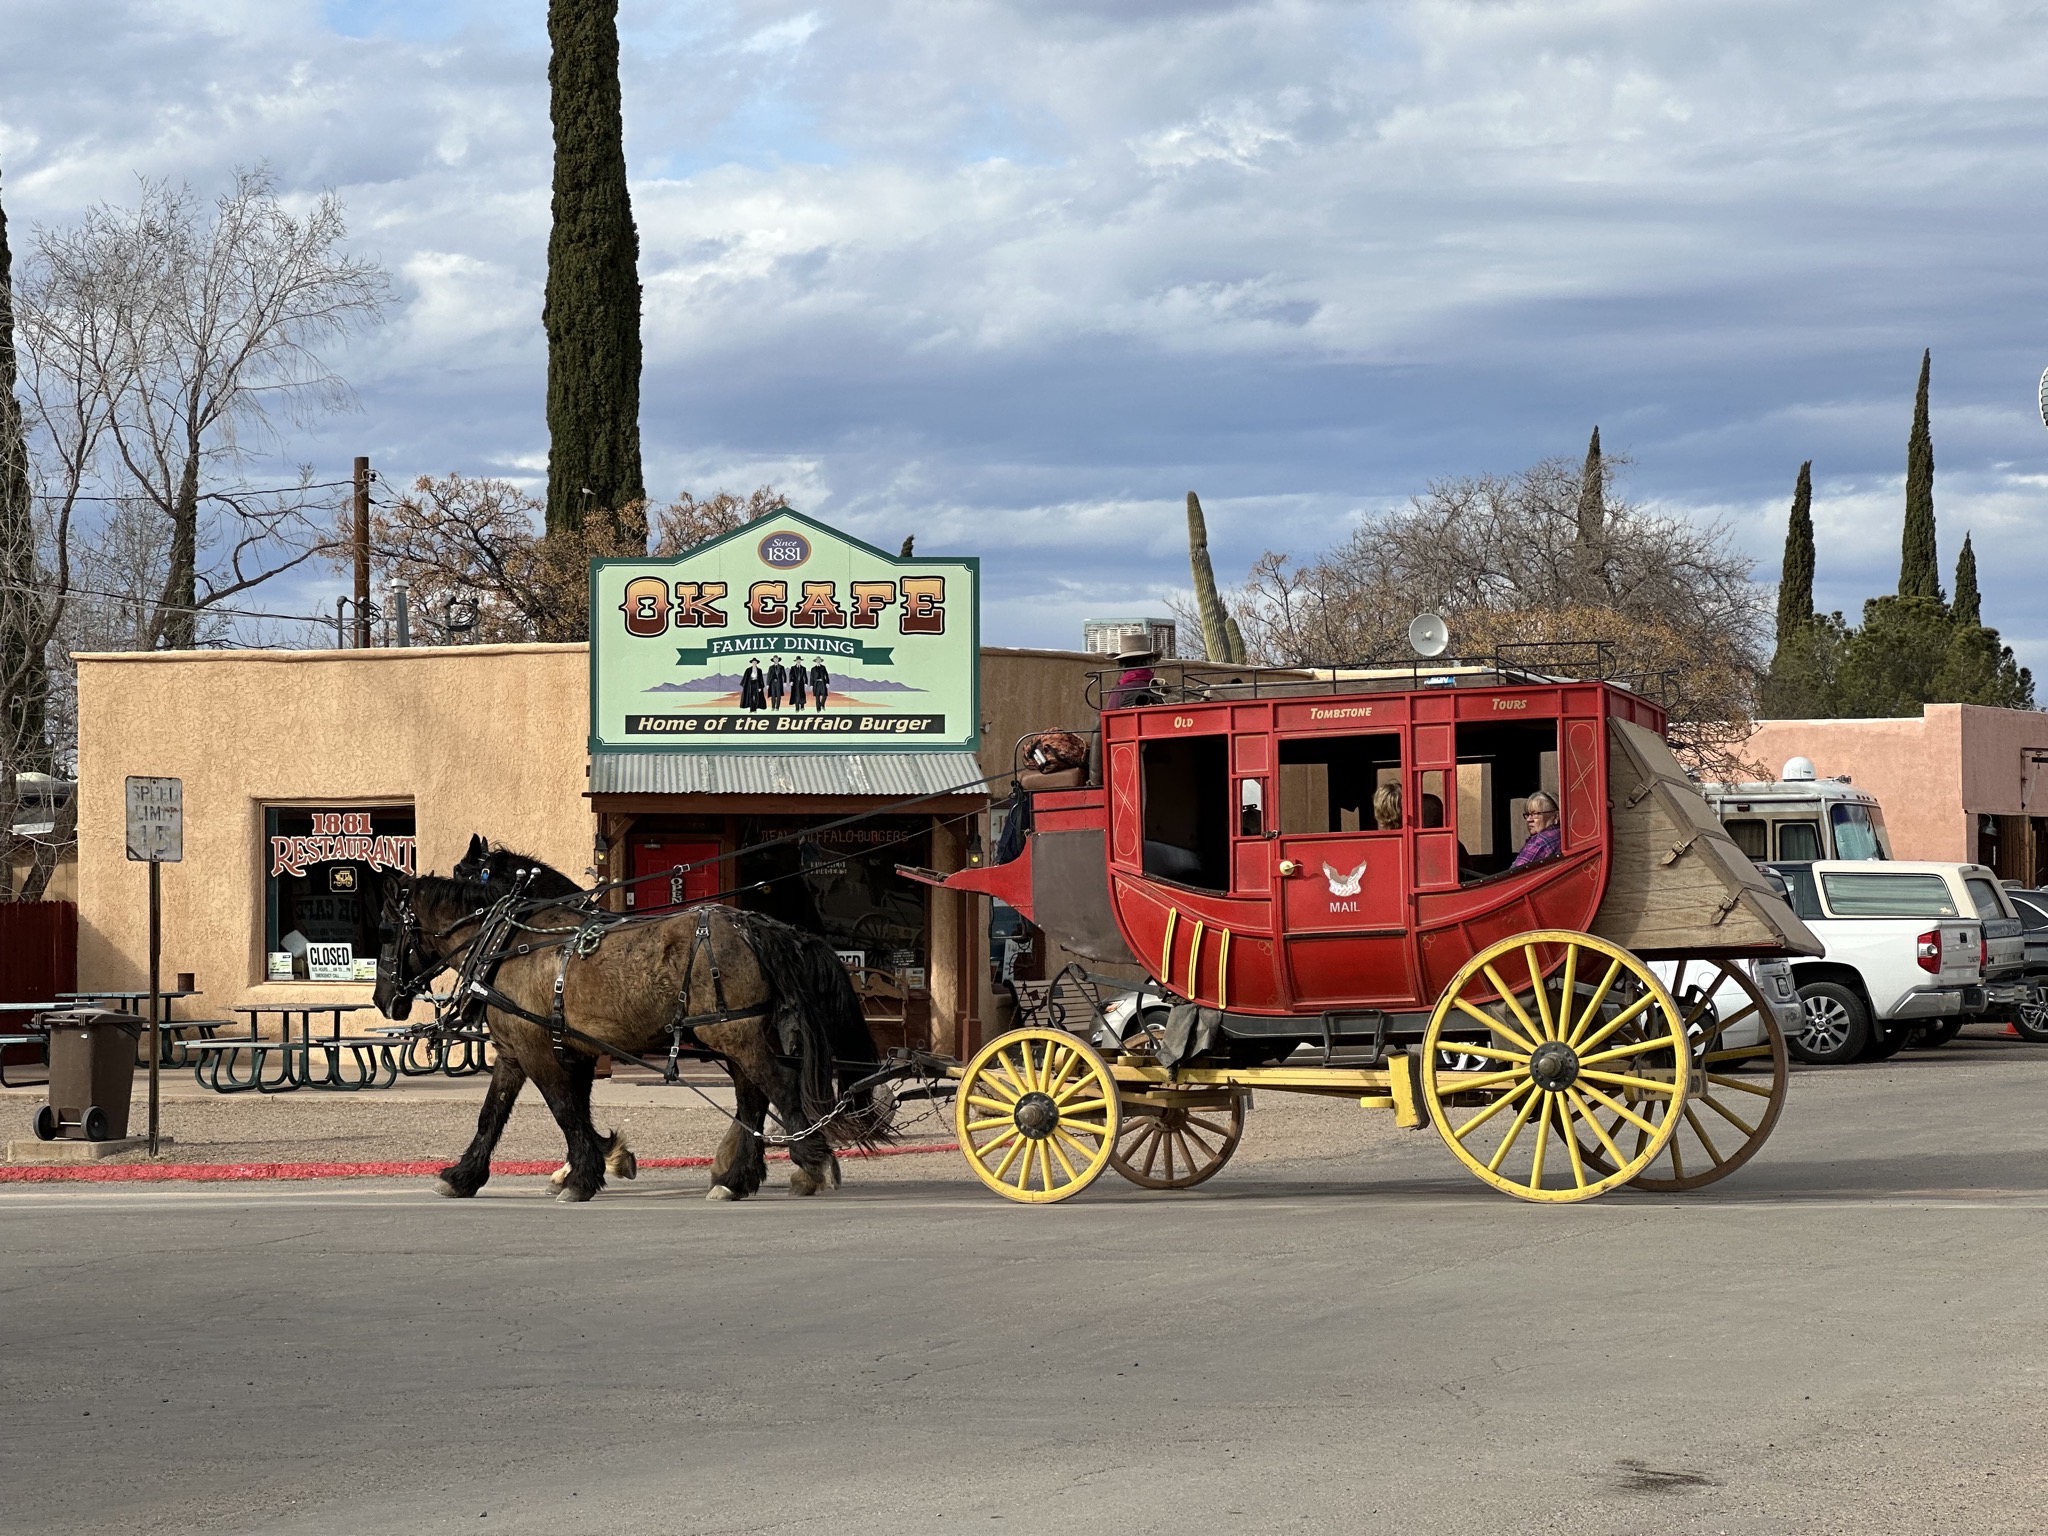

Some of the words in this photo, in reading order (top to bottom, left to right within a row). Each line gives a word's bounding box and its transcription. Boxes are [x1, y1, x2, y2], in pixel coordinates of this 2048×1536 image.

[772, 538, 797, 547] Since
[767, 547, 802, 561] 1881
[618, 576, 728, 638] OK
[744, 575, 946, 635] CAFE
[712, 637, 778, 654] FAMILY
[784, 637, 854, 654] DINING
[638, 717, 698, 731] Home
[703, 717, 728, 731] of
[735, 717, 770, 731] the
[776, 716, 853, 731] Buffalo
[859, 716, 932, 733] Burger
[311, 812, 374, 836] 1881
[270, 834, 416, 878] RESTAURANT
[671, 877, 683, 905] OPEN
[1329, 901, 1361, 913] MAIL
[309, 947, 350, 966] CLOSED
